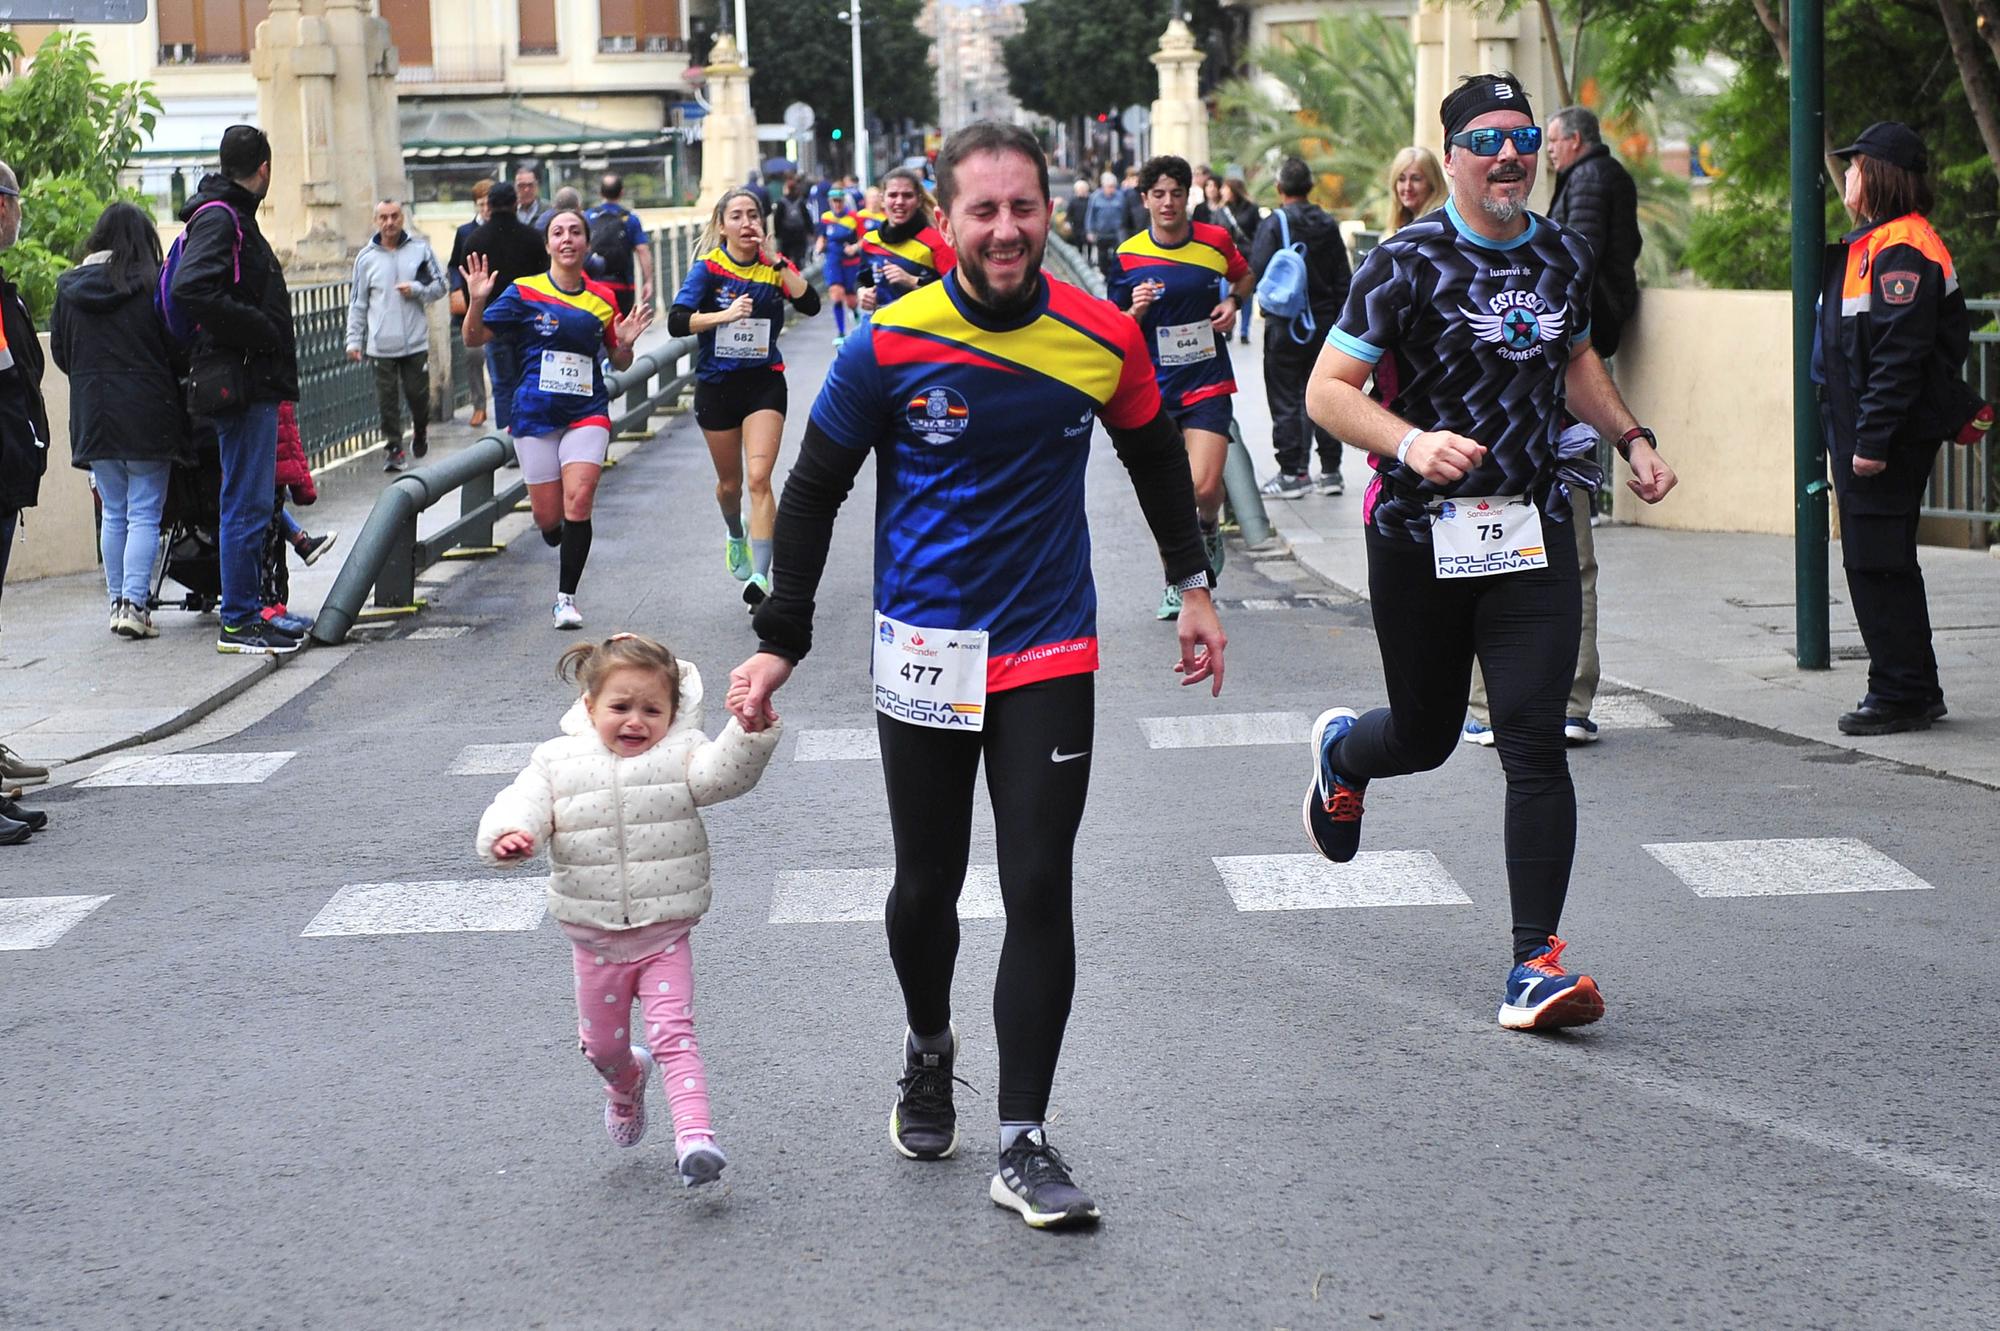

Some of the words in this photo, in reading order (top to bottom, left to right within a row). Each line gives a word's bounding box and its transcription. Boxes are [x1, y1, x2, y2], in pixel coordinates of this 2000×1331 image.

[1489, 267, 1521, 277] luanvi
[1489, 290, 1547, 314] ESTESO
[734, 333, 754, 342] 682
[1177, 338, 1198, 348] 644
[1495, 345, 1543, 361] RUNNERS
[560, 367, 579, 377] 123
[1466, 509, 1504, 519] Santander
[1477, 523, 1504, 541] 75
[1439, 550, 1522, 565] POLICIA
[1440, 558, 1545, 575] NACIONAL
[901, 642, 938, 657] Santander
[900, 662, 943, 685] 477
[875, 685, 955, 713] POLICIA
[875, 696, 981, 726] NACIONAL
